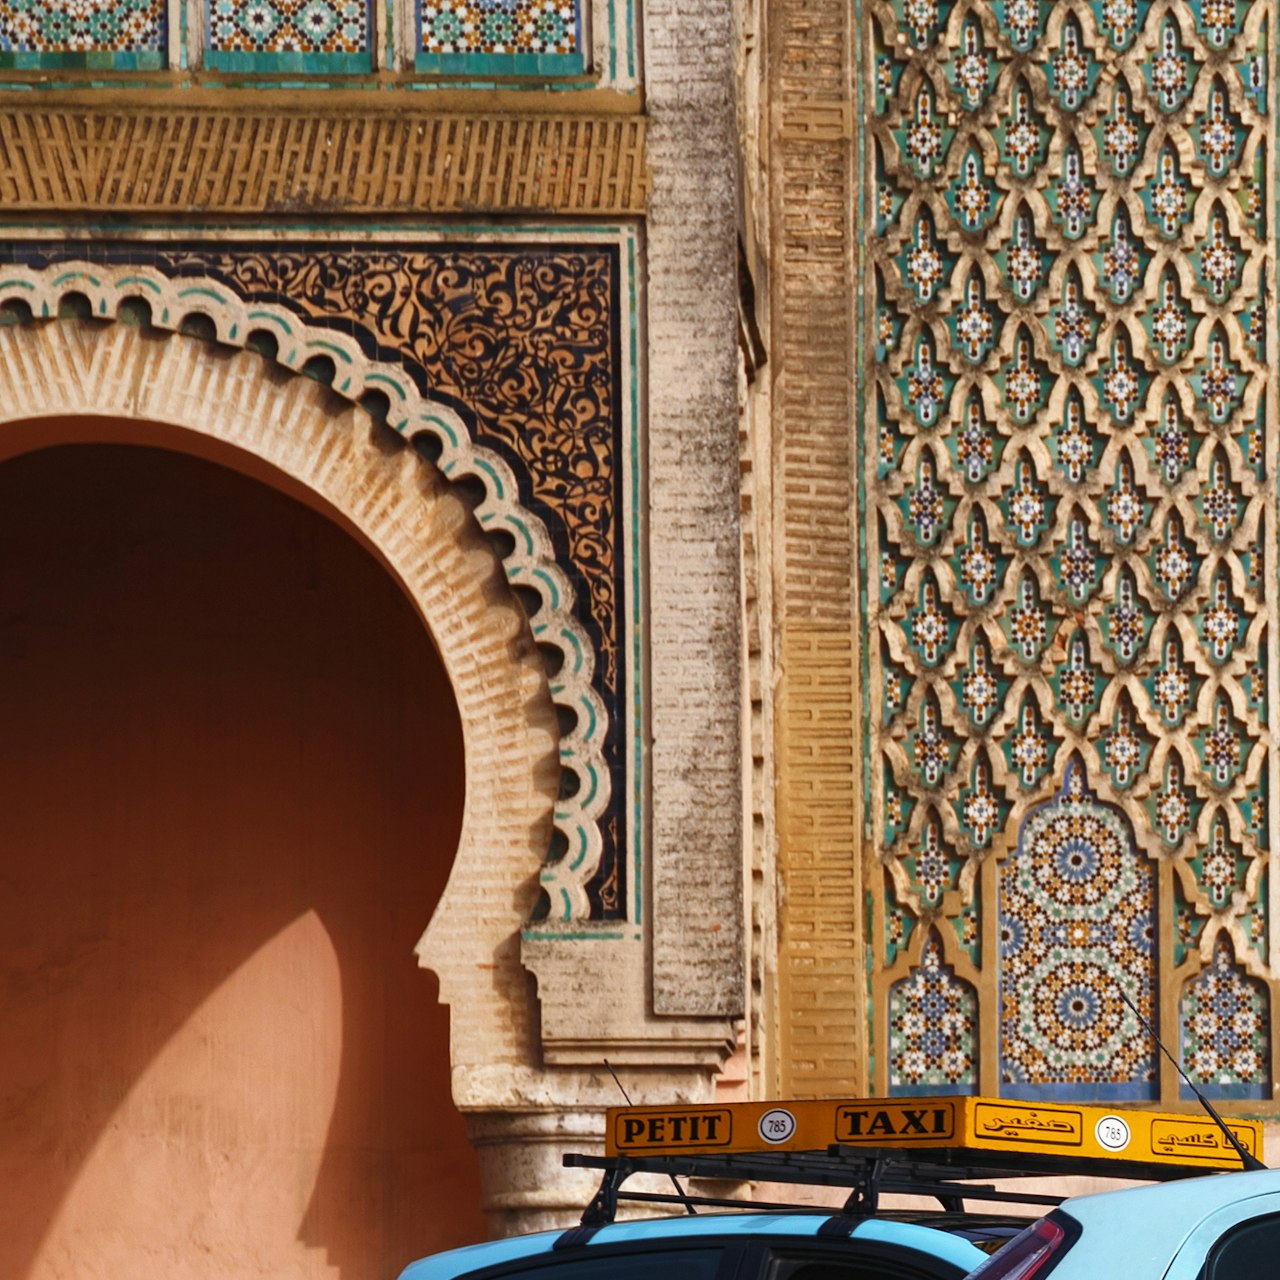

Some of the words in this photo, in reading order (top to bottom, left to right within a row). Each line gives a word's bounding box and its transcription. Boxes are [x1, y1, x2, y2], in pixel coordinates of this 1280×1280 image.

[624, 1115, 721, 1143] PETIT
[769, 1120, 786, 1133] 785
[843, 1110, 946, 1136] TAXI
[983, 1112, 1074, 1136] صغير
[1105, 1126, 1121, 1141] 785
